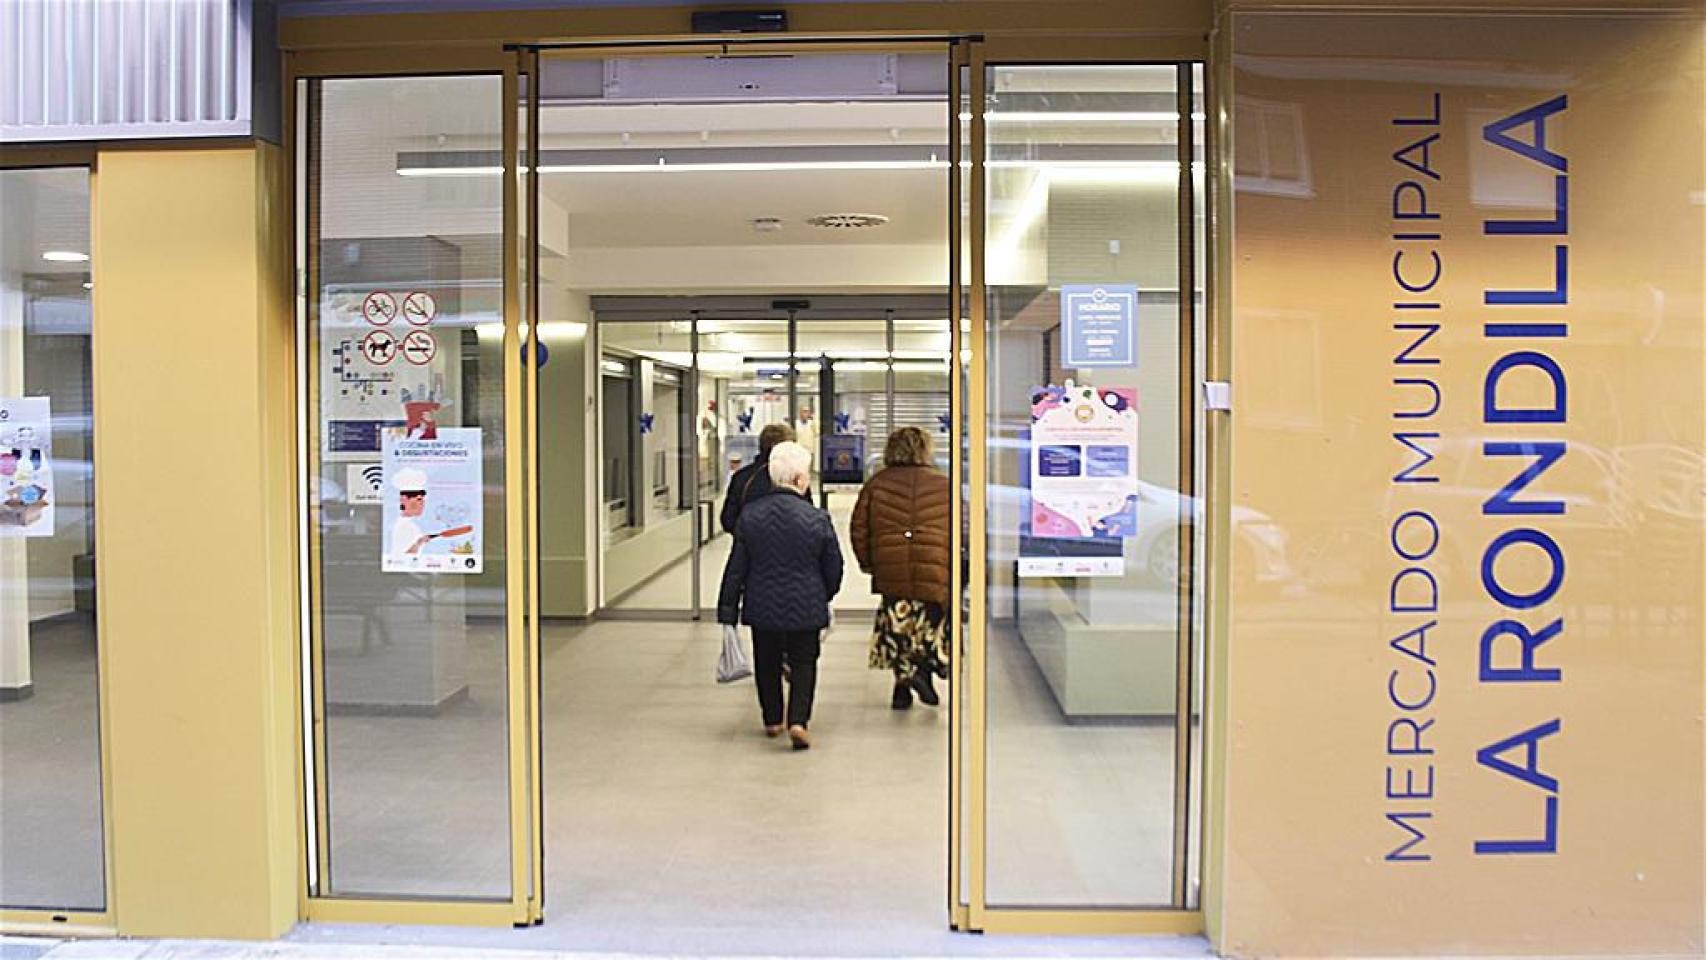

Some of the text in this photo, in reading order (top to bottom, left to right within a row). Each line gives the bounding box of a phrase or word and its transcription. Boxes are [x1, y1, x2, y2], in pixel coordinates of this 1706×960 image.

[1385, 93, 1441, 861] MERCADO MUNICIPAL
[1473, 95, 1569, 855] LA RONDILLA
